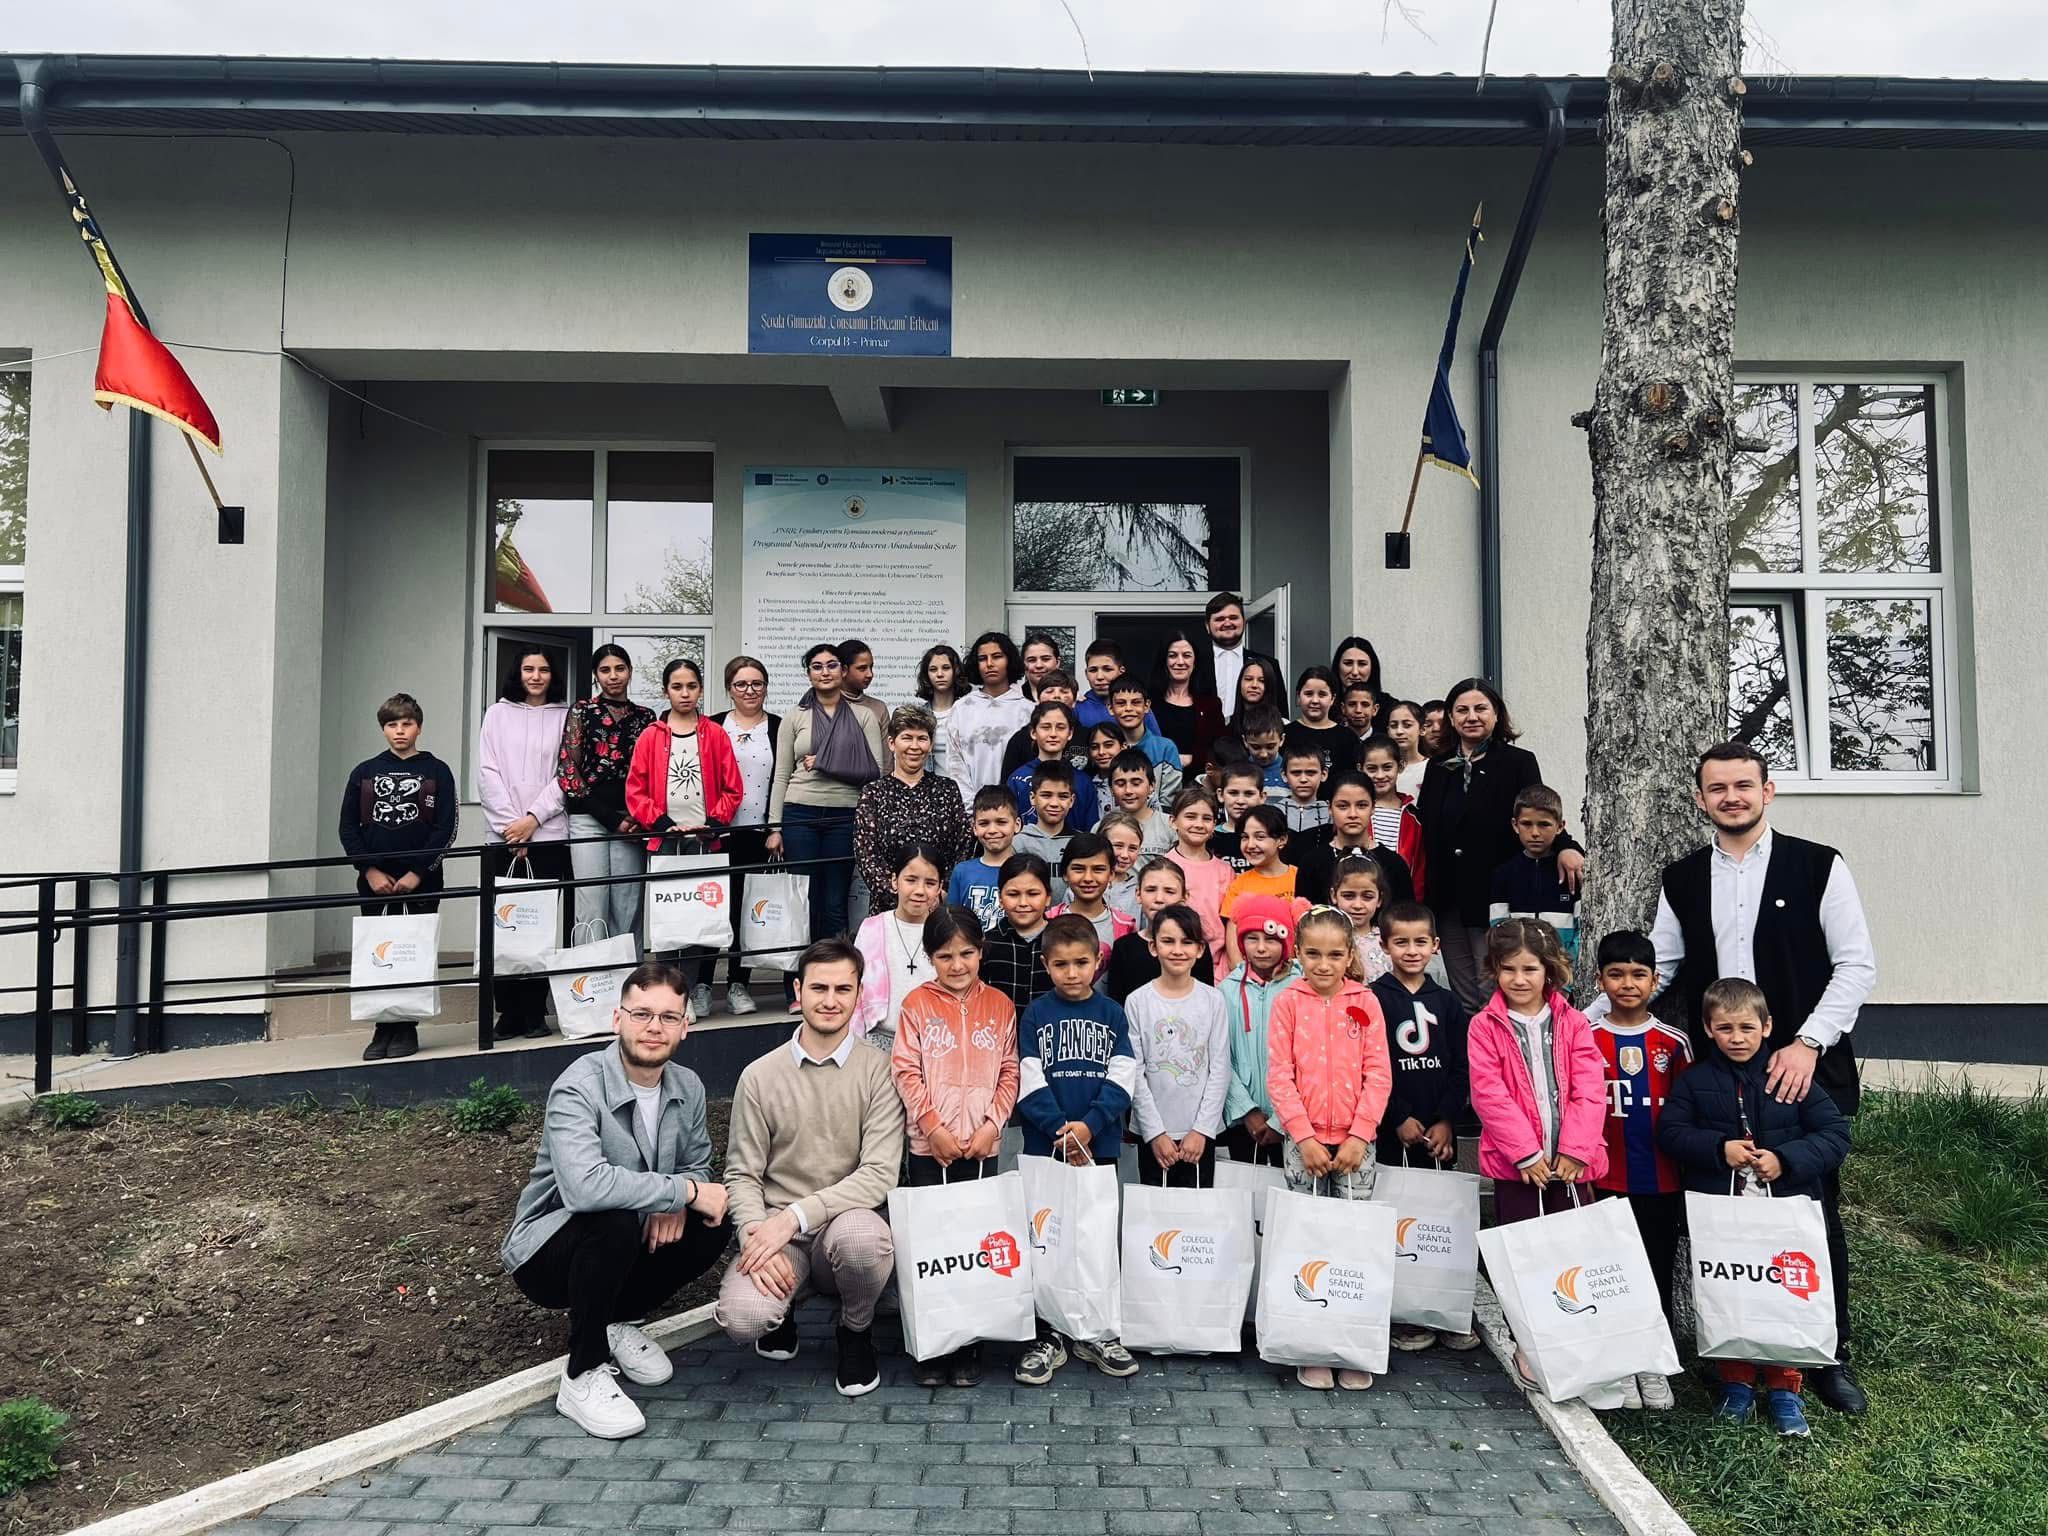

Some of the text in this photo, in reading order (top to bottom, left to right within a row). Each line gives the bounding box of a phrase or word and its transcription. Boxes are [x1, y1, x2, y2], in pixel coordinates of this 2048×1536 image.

[810, 336, 841, 349] Corpul
[843, 336, 850, 346] B
[860, 337, 890, 348] Primar
[1398, 1056, 1442, 1071] TikTok
[1417, 1223, 1452, 1234] COLEGIUL
[1181, 1235, 1216, 1244] COLEGIUL
[1417, 1244, 1452, 1254] NICOLAE
[1181, 1256, 1216, 1265] NICOLAE
[1329, 1267, 1365, 1280] COLEGIUL
[1584, 1264, 1624, 1278] COLEGIUL
[1328, 1289, 1364, 1301] NICOLAE
[1592, 1286, 1630, 1300] NICOLAE
